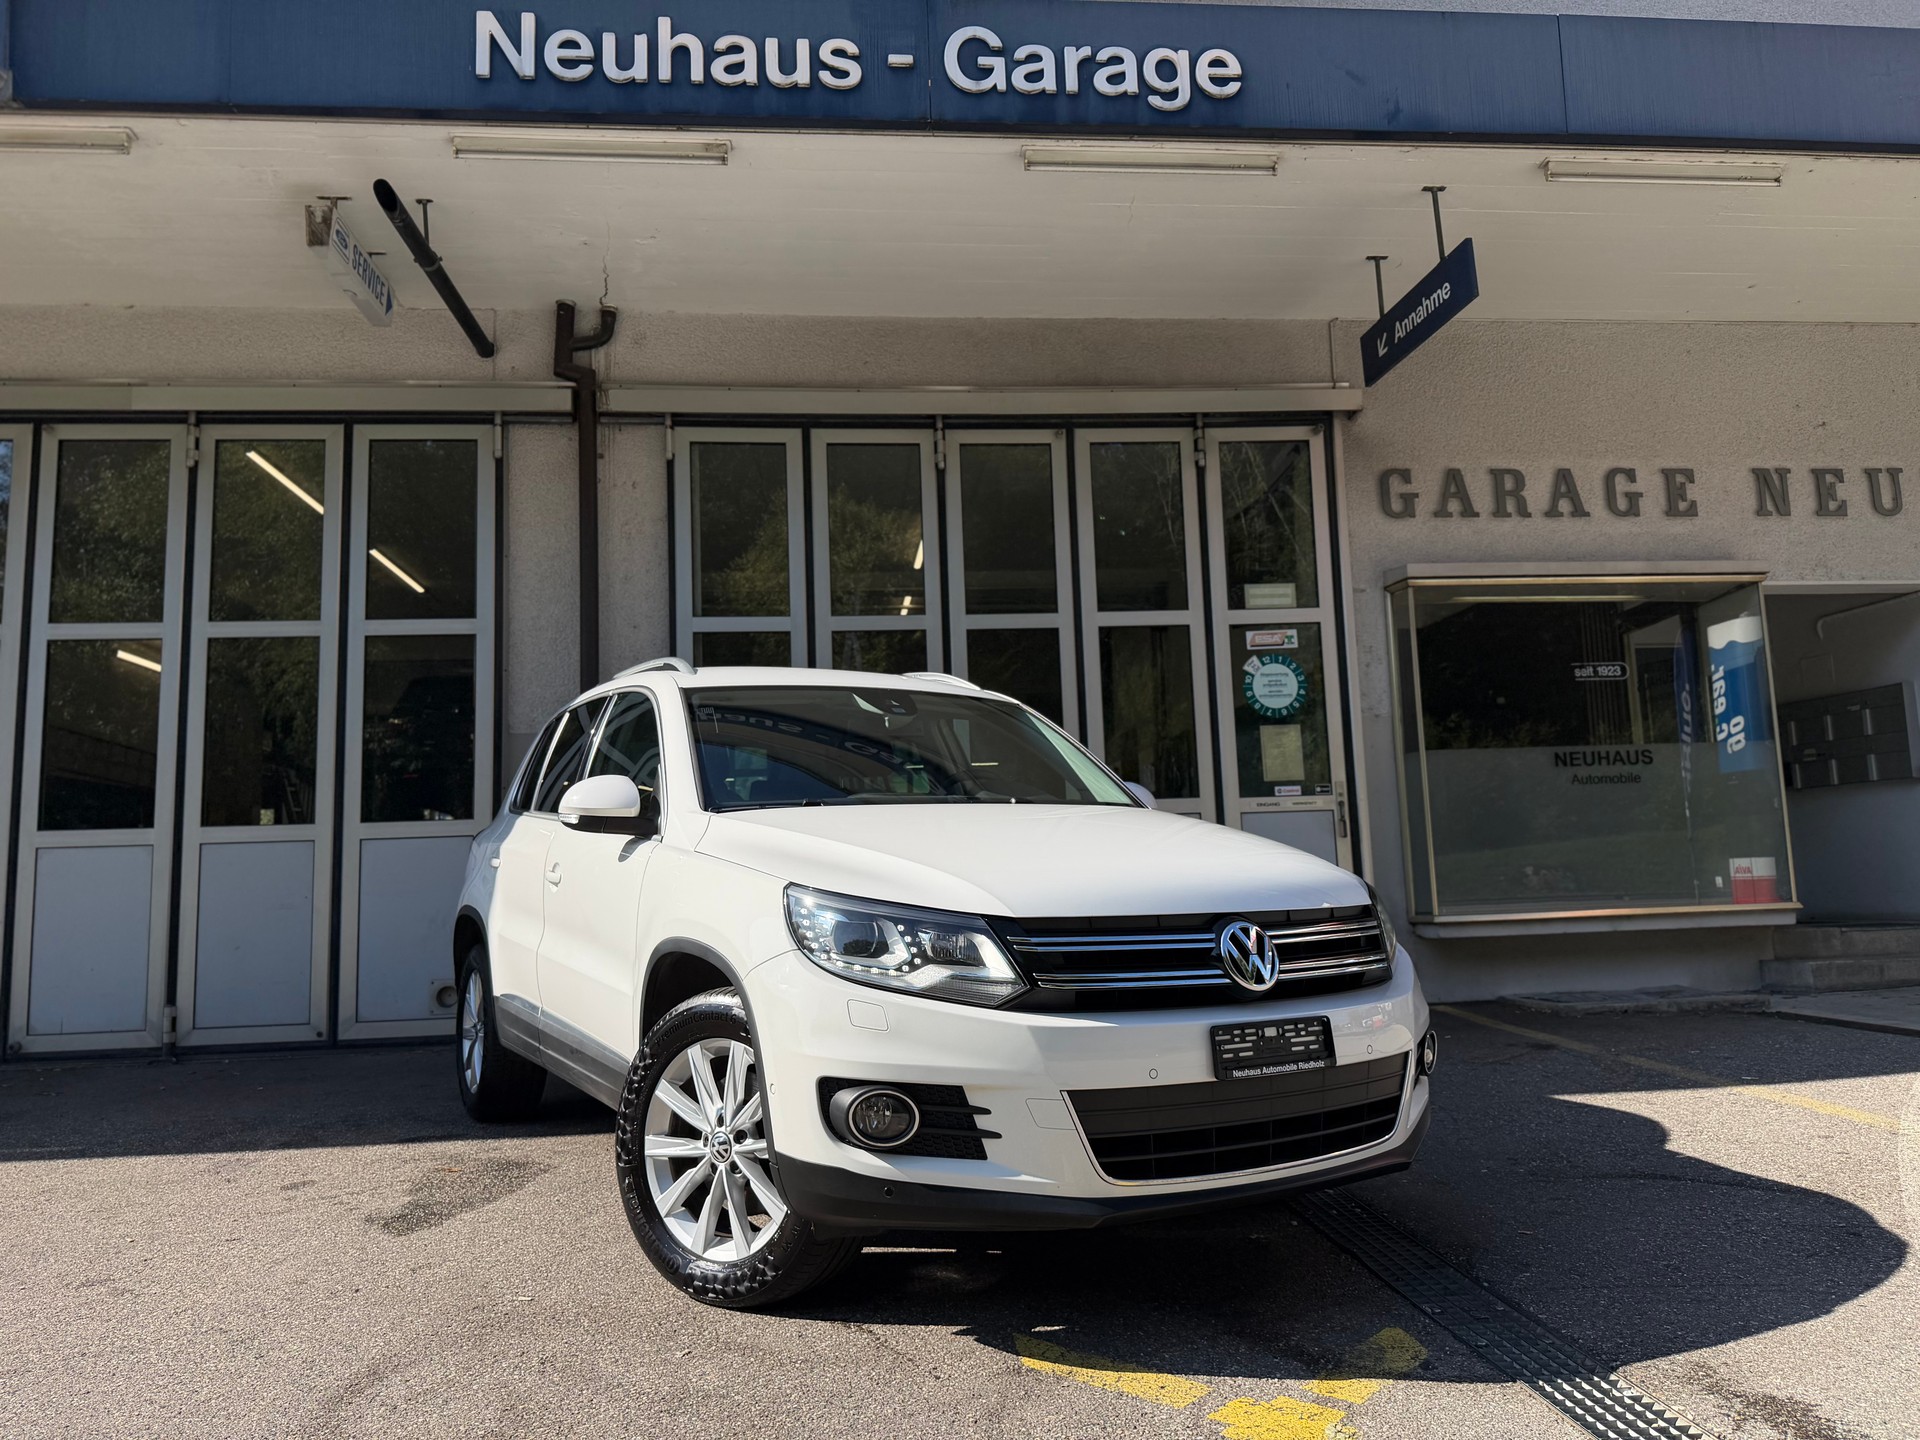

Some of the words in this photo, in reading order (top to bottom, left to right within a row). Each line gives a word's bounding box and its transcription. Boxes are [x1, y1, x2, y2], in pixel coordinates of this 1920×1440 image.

[474, 10, 862, 91] Neuhaus
[887, 53, 914, 68] -
[942, 26, 1243, 111] Garage
[352, 244, 386, 306] SERVICE
[1394, 282, 1451, 344] Annahme
[1378, 467, 1699, 520] GARAGE
[1751, 467, 1904, 518] NEU
[1574, 666, 1594, 677] seit
[1597, 665, 1622, 676] 1923
[1554, 749, 1654, 768] NEUHAUS
[1571, 772, 1642, 785] Automobile
[1232, 1066, 1262, 1078] Neuhaus
[1262, 1062, 1298, 1075] Automobile
[1298, 1059, 1325, 1070] Riedholz
